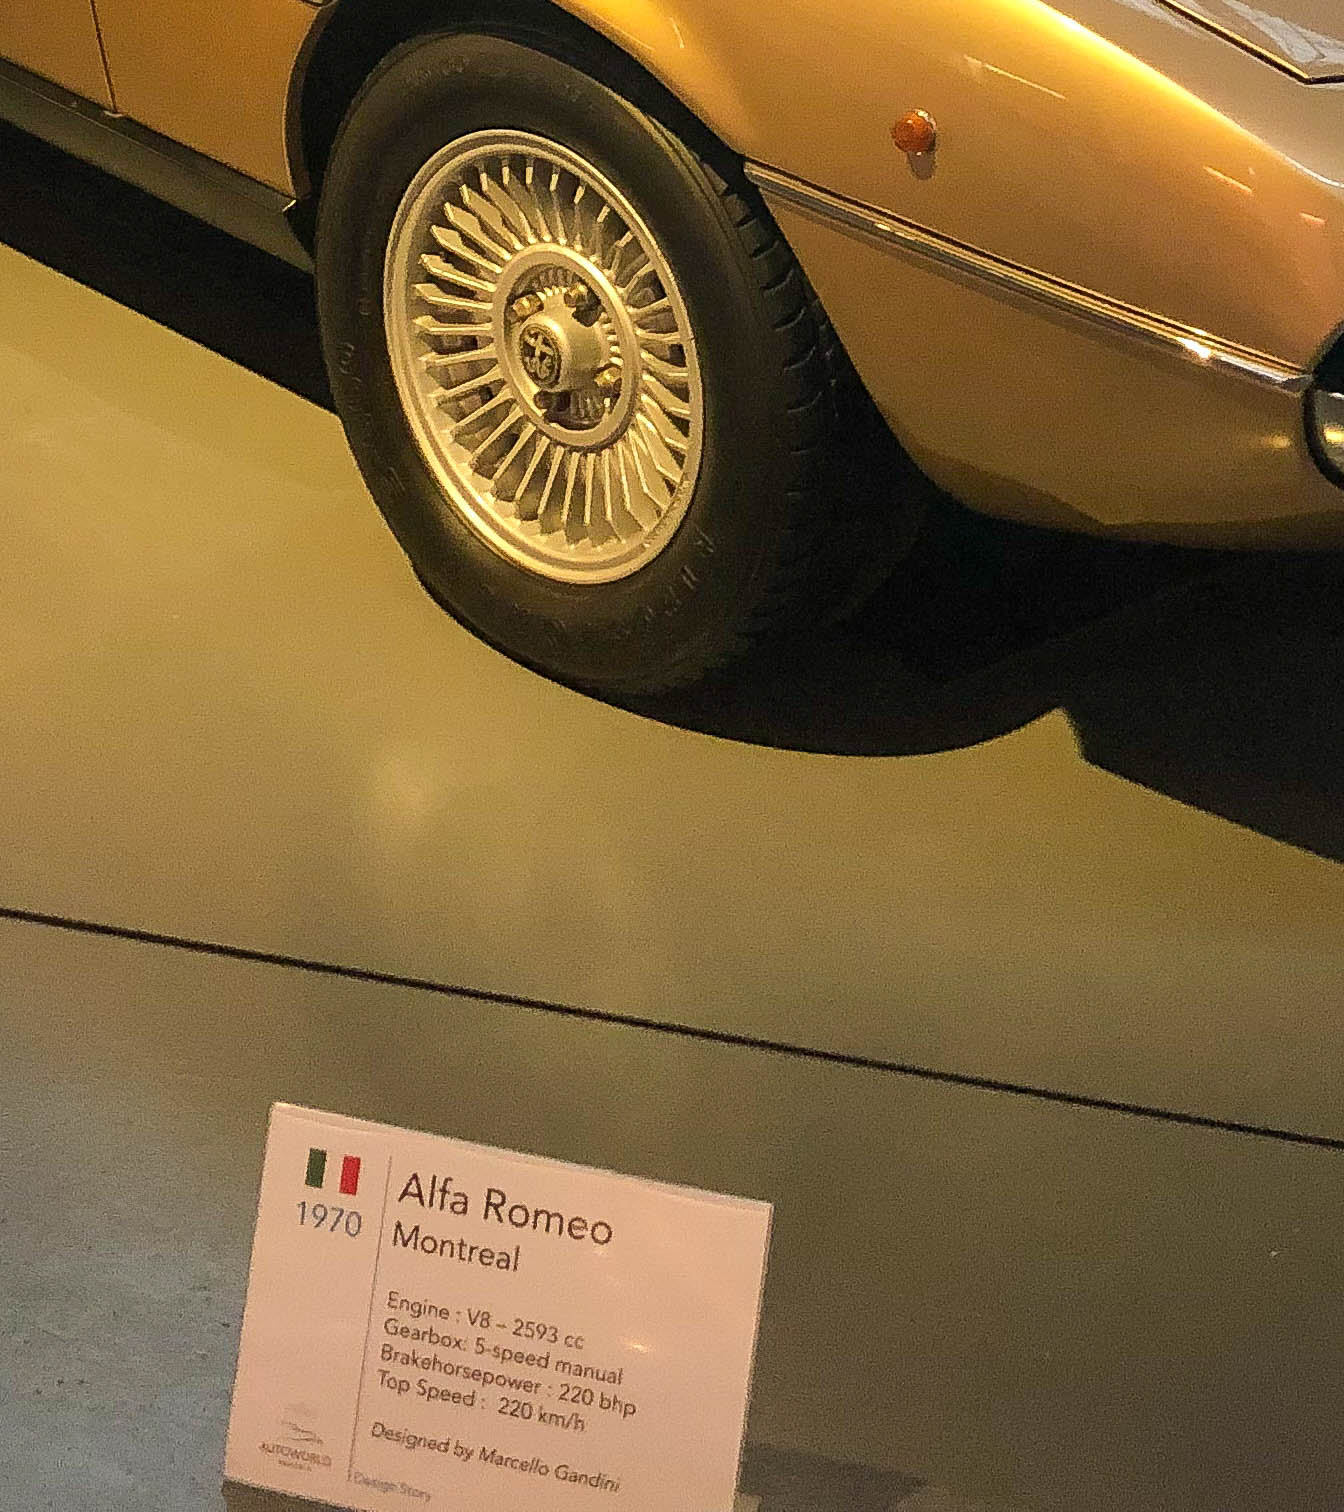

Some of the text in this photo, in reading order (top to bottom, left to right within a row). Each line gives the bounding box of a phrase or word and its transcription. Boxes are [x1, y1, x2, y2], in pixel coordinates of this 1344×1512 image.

[297, 1201, 362, 1237] 1970
[398, 1172, 613, 1245] Alfa Romeo
[393, 1220, 520, 1272] Montreal
[384, 1318, 624, 1385] Gearbox: 5-speed manual
[387, 1291, 450, 1319] Engine
[467, 1308, 491, 1328] V8
[512, 1318, 559, 1344] 2593
[564, 1335, 585, 1349] cc
[377, 1369, 411, 1396] Top
[416, 1378, 477, 1407] Speed
[498, 1397, 534, 1420] 220
[538, 1406, 586, 1432] km/h
[381, 1343, 542, 1394] Brakehorsepower
[558, 1383, 595, 1406] 220
[599, 1391, 637, 1419] bhp
[371, 1421, 621, 1492] Designed by Marcello Gandini
